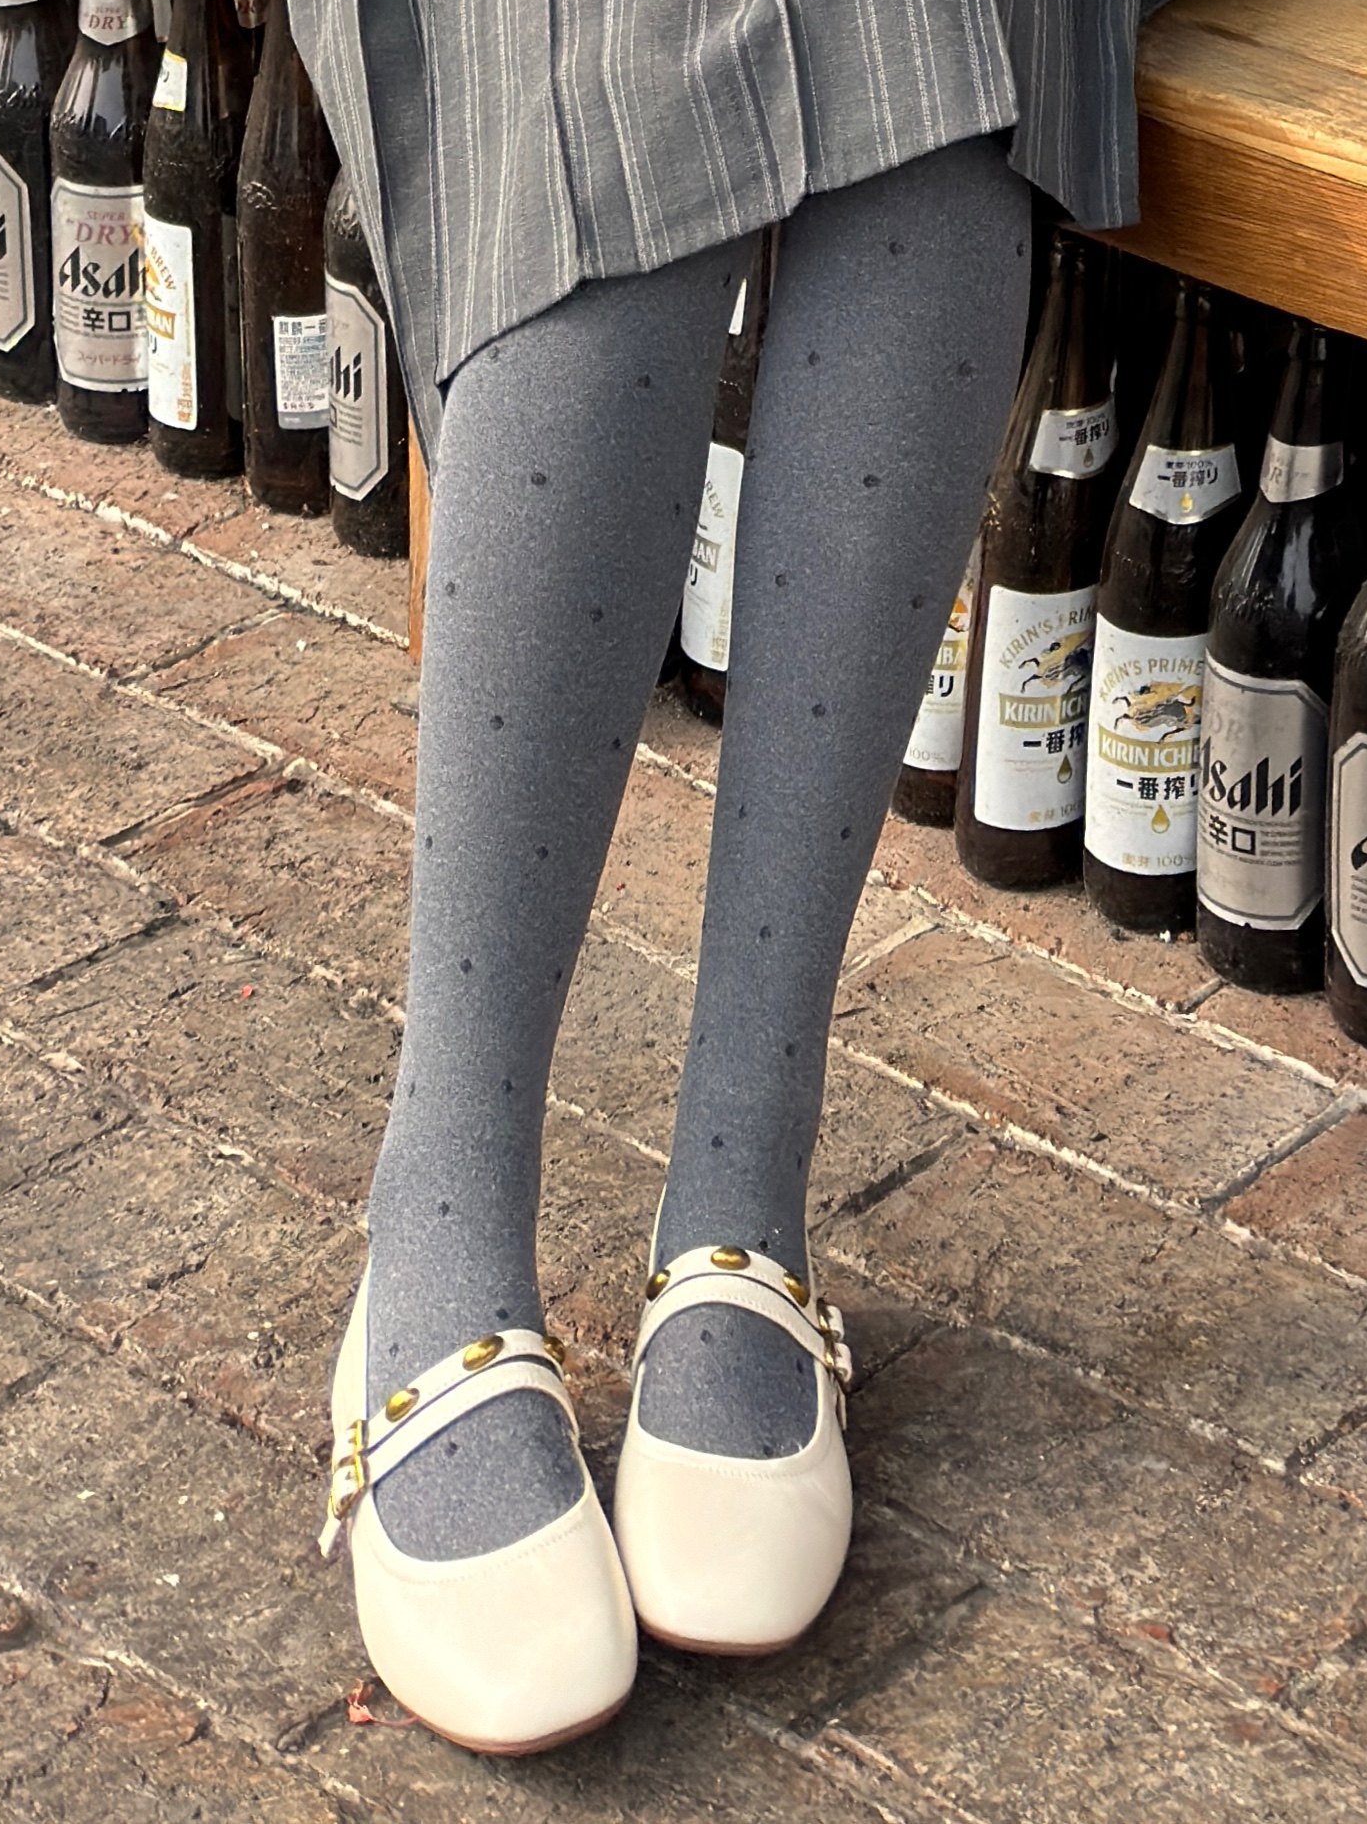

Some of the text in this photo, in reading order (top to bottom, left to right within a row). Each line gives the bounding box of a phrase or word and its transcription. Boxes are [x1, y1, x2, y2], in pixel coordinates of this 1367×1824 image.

[87, 14, 128, 30] DRY
[81, 309, 132, 332] 辛口
[1058, 422, 1110, 446] 一番搾り
[1157, 467, 1218, 490] 一番搾り
[998, 617, 1055, 670] KIRIN'S
[1099, 658, 1204, 702] KIRIN'S PRIME
[1004, 701, 1058, 724] KIRIN
[1100, 737, 1150, 766] KIRIN
[1208, 814, 1256, 855] 辛口
